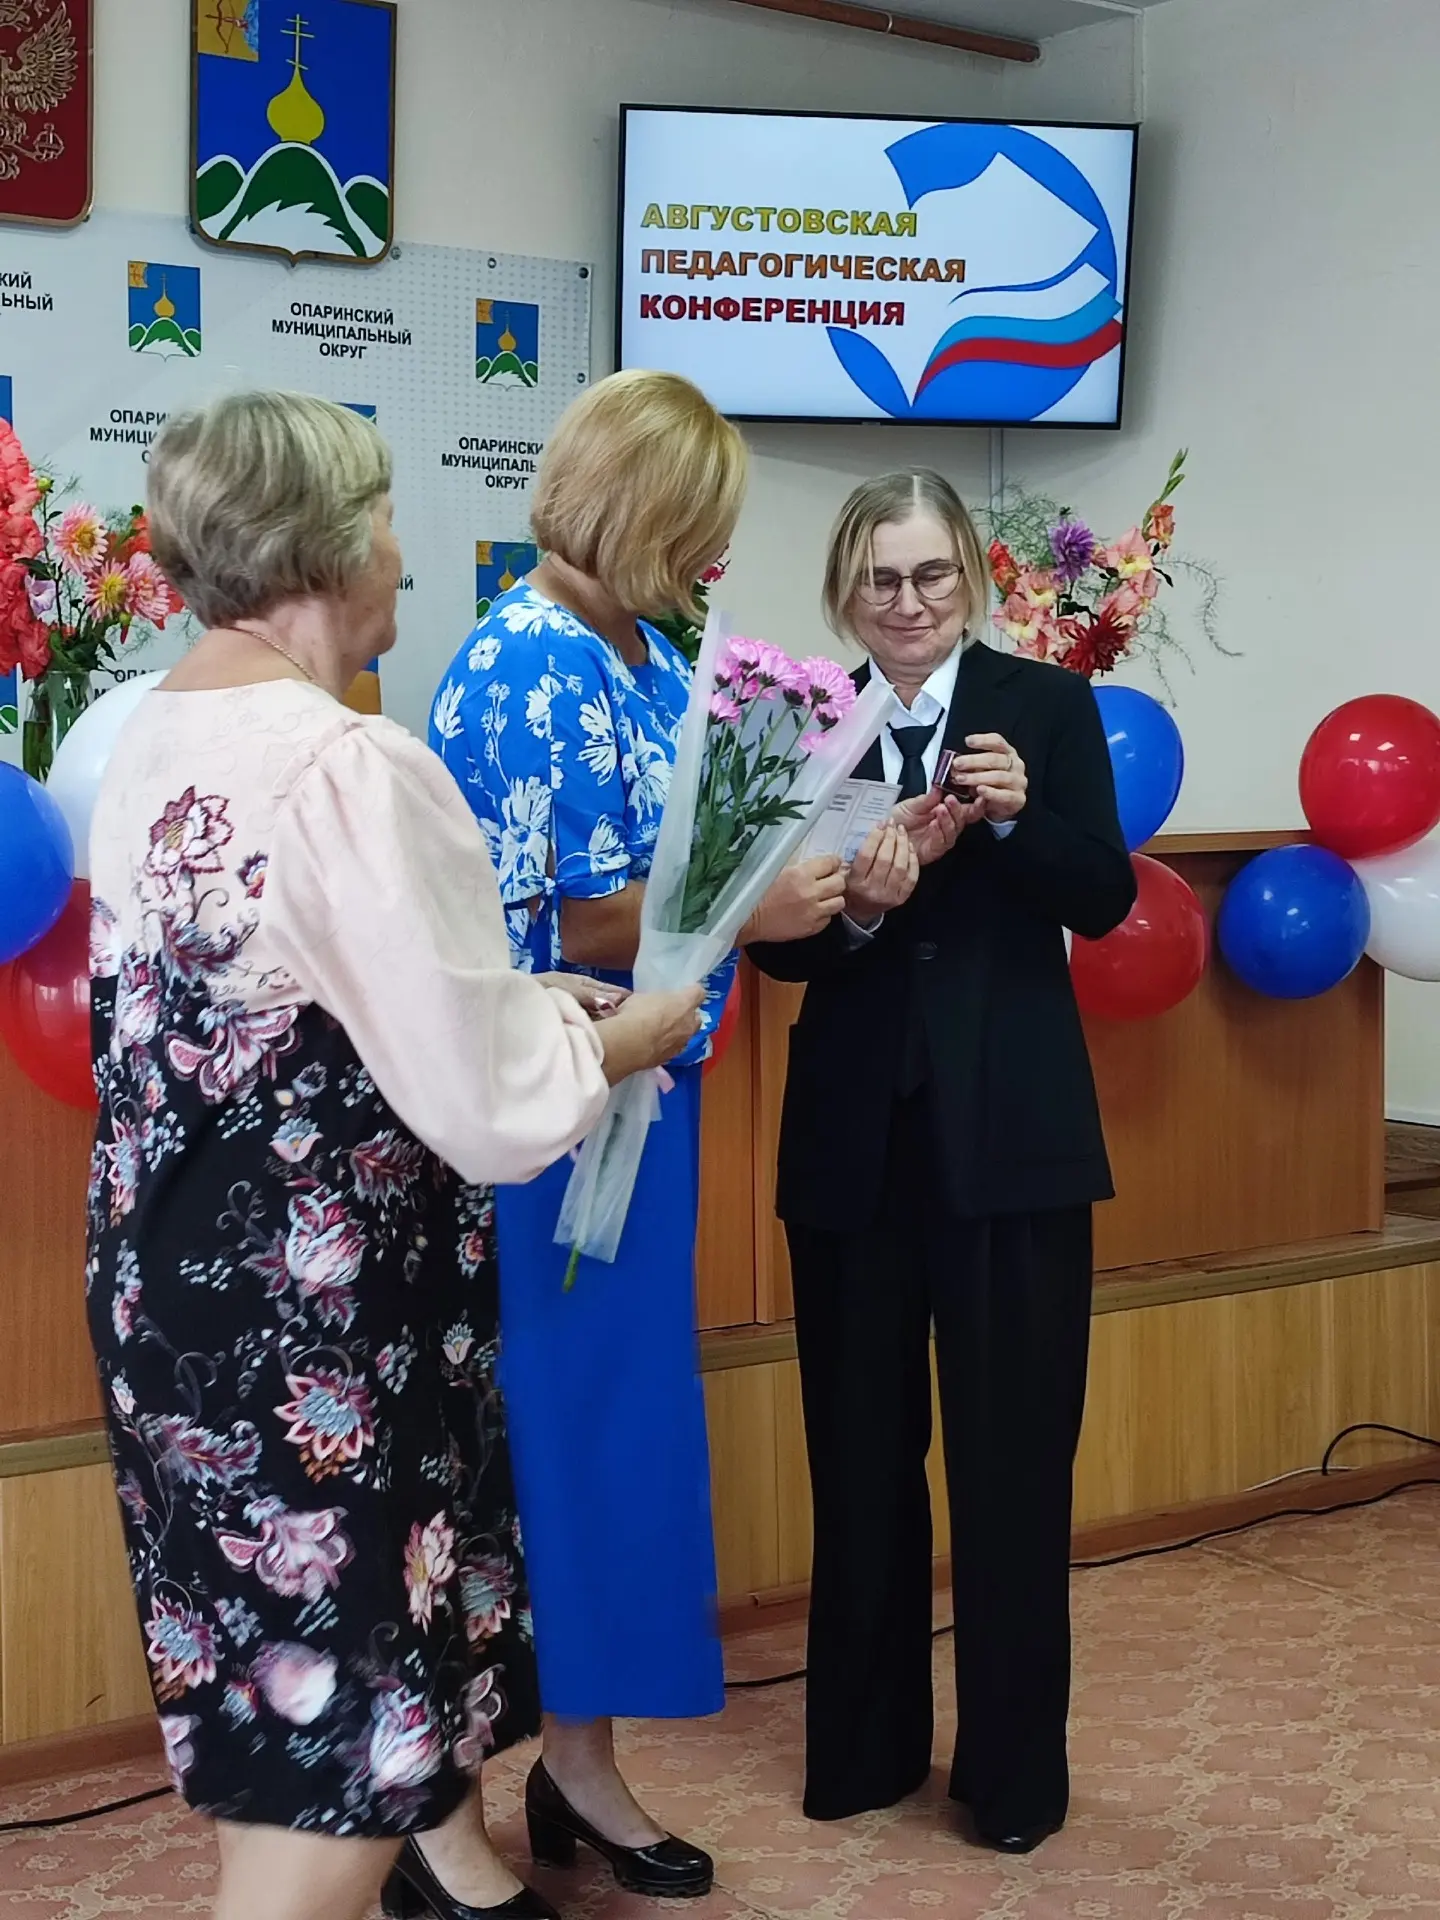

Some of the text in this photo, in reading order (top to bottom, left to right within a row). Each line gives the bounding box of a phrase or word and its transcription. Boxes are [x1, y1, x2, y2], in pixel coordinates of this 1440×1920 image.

[640, 203, 917, 237] АВГУСТОВСКАЯ
[641, 249, 966, 283] ПЕДАГОГИЧЕСКАЯ
[290, 302, 394, 325] ОПАРИНСКИЙ
[640, 294, 905, 329] КОНФЕРЕНЦИЯ
[272, 319, 412, 345] МУНИЦИПАЛЬНЫЙ
[319, 342, 368, 359] ОКРУГ
[109, 409, 170, 426] ОПАРИ
[89, 427, 157, 447] МУНИЦИ
[458, 436, 544, 455] ОПАРИНСКИ
[441, 453, 537, 473] МУНИЦИПАЛЬ
[485, 474, 529, 490] ОКРУГ
